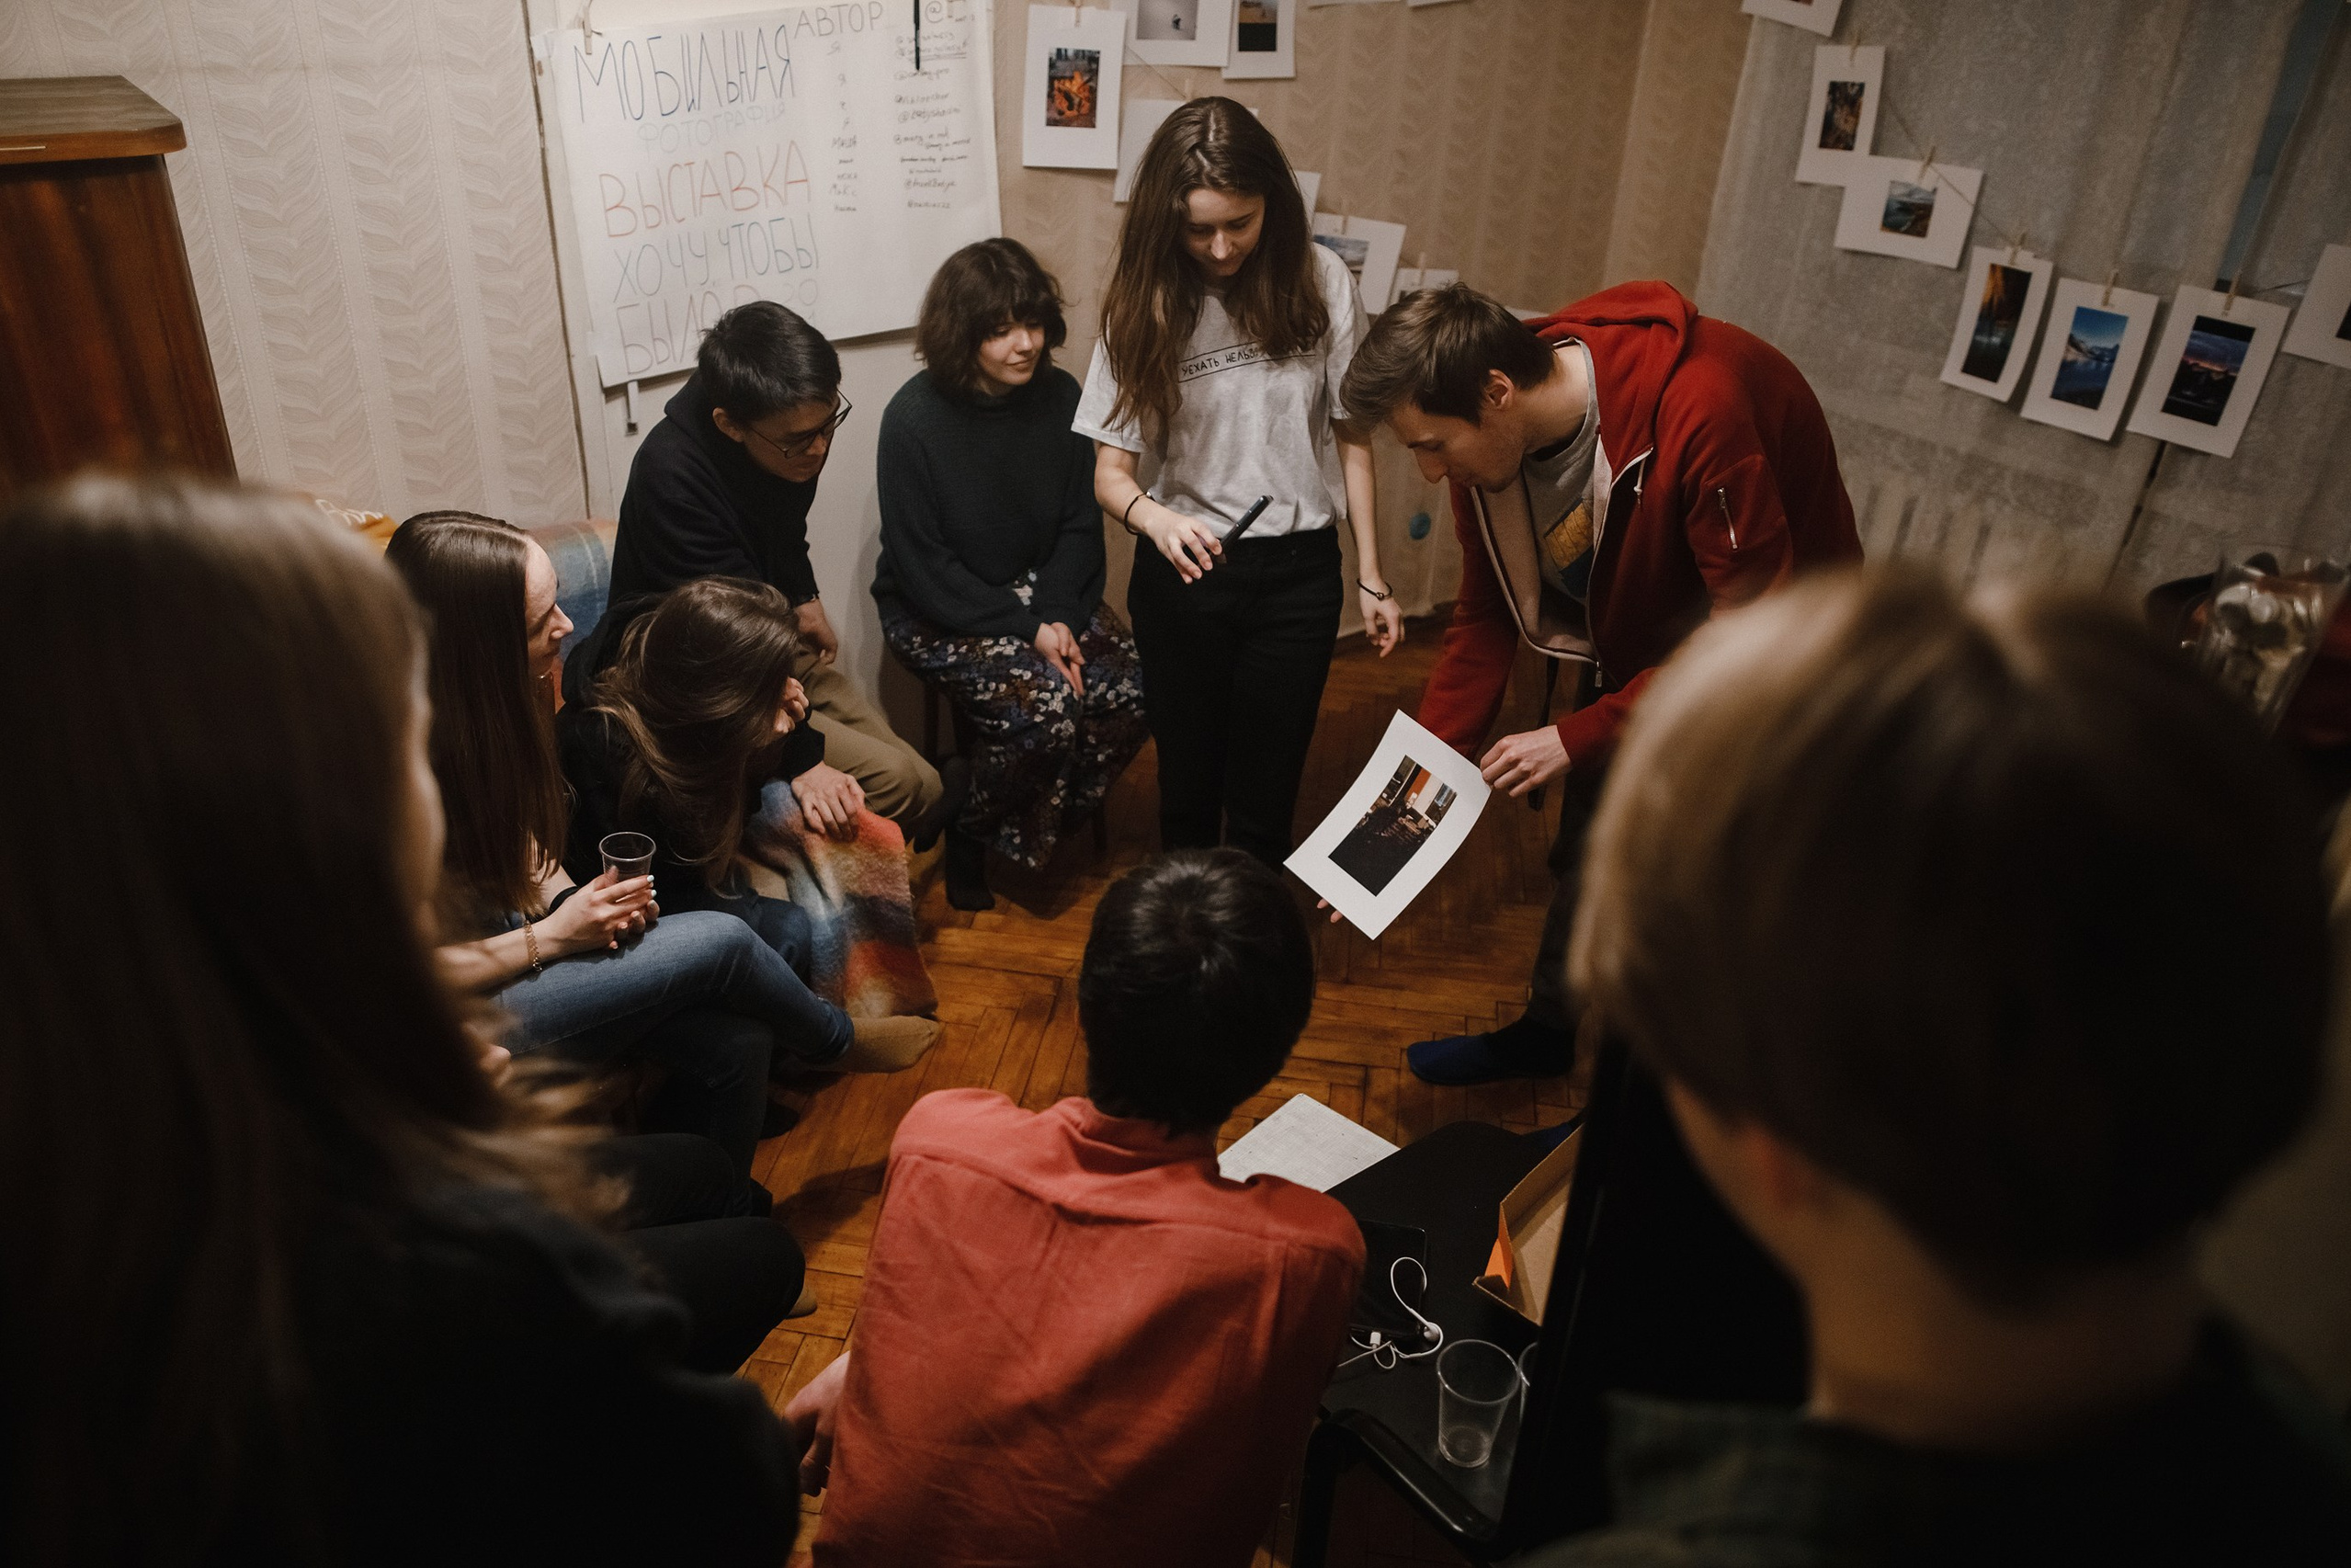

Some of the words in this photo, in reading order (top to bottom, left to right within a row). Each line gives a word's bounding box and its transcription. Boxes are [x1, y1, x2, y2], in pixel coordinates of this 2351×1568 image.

[793, 0, 883, 39] АВТОР
[573, 24, 796, 124] МОБИЛЬНАЯ
[598, 140, 812, 238] ВЫСТАВКА
[718, 212, 821, 280] ЧТОБЫ
[1181, 357, 1221, 376] УЕХАТЬ
